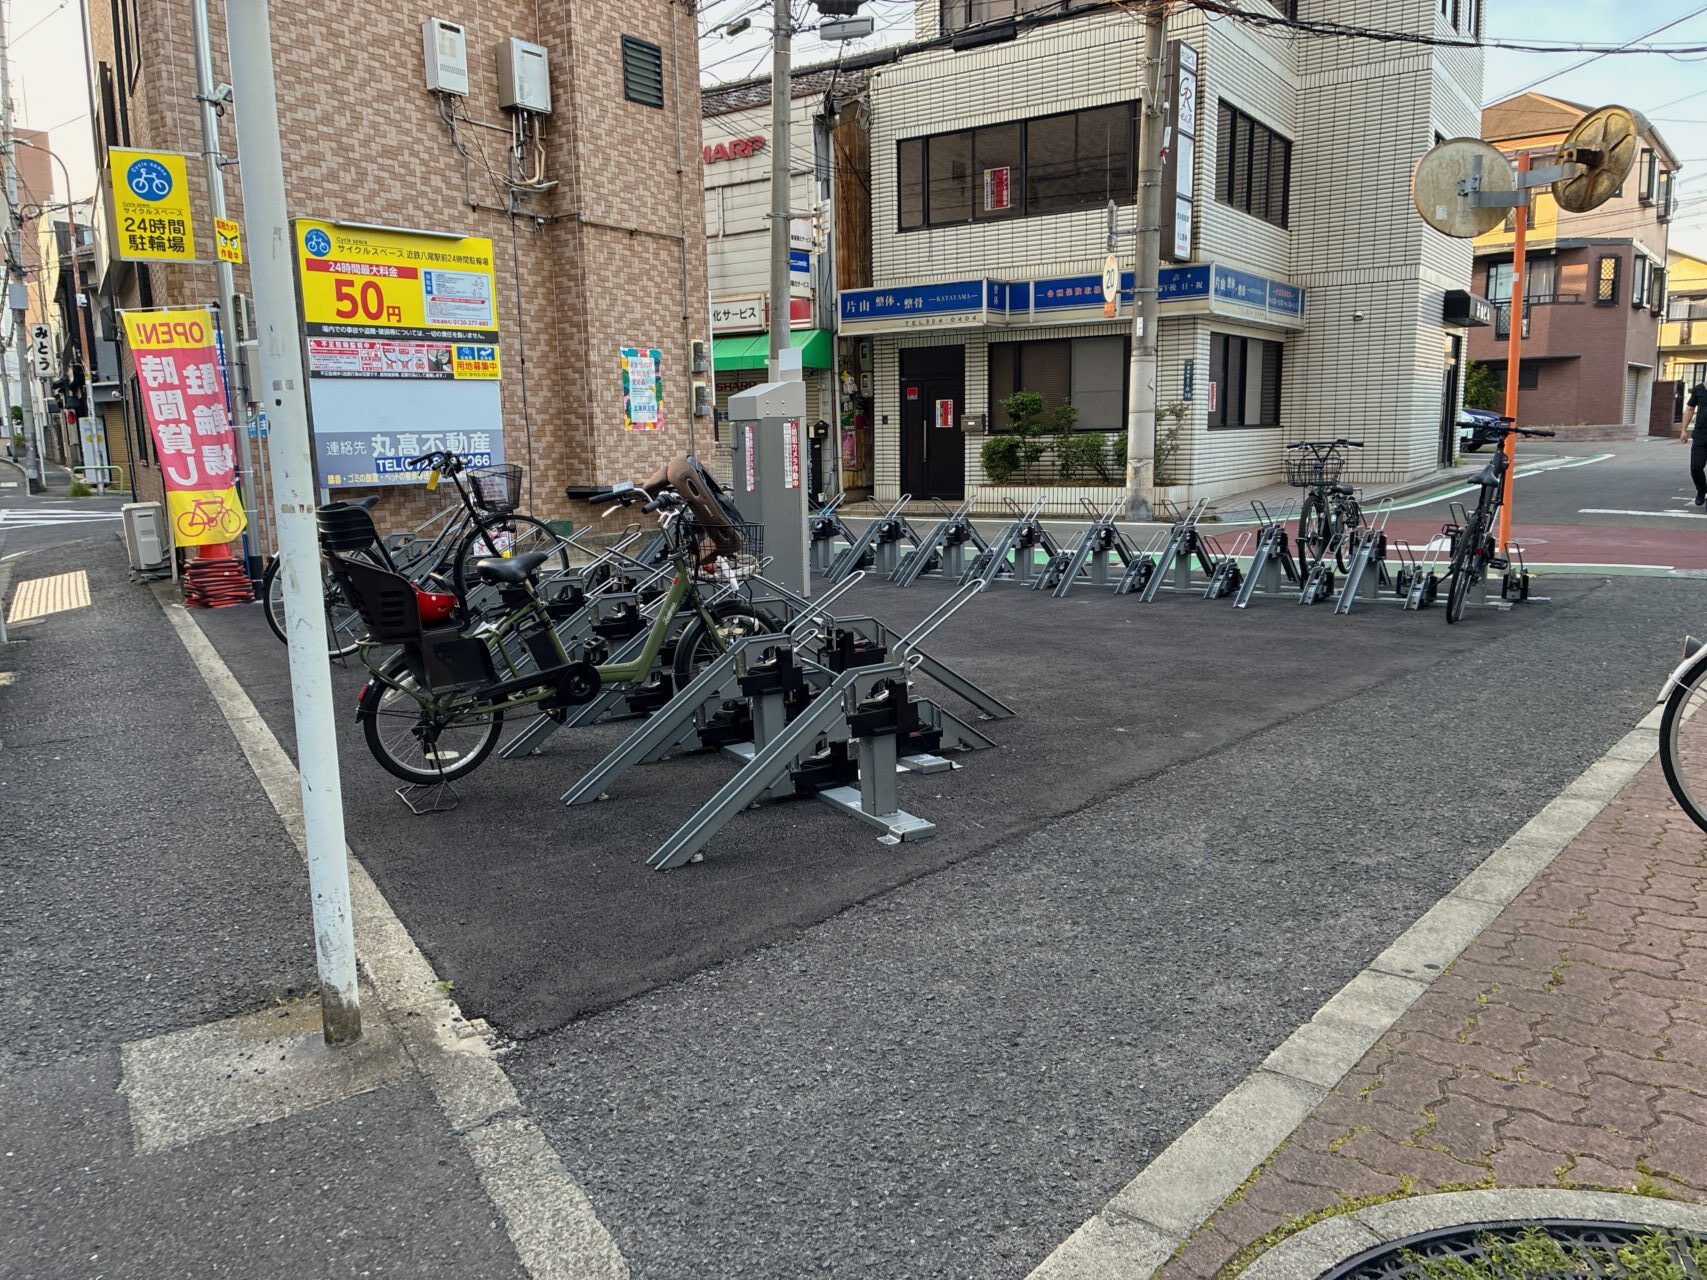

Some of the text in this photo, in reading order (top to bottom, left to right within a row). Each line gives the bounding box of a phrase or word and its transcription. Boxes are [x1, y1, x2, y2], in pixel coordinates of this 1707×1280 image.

[124, 217, 187, 236] 24時間
[128, 234, 185, 253] 駐輪場
[337, 244, 405, 258] サイクルスペース
[328, 261, 398, 278] 24時間最大料金
[1106, 269, 1115, 289] 20
[846, 299, 870, 313] 片山
[34, 326, 51, 371] みとう
[457, 361, 497, 371] 用地募集中
[326, 441, 367, 456] 連絡先
